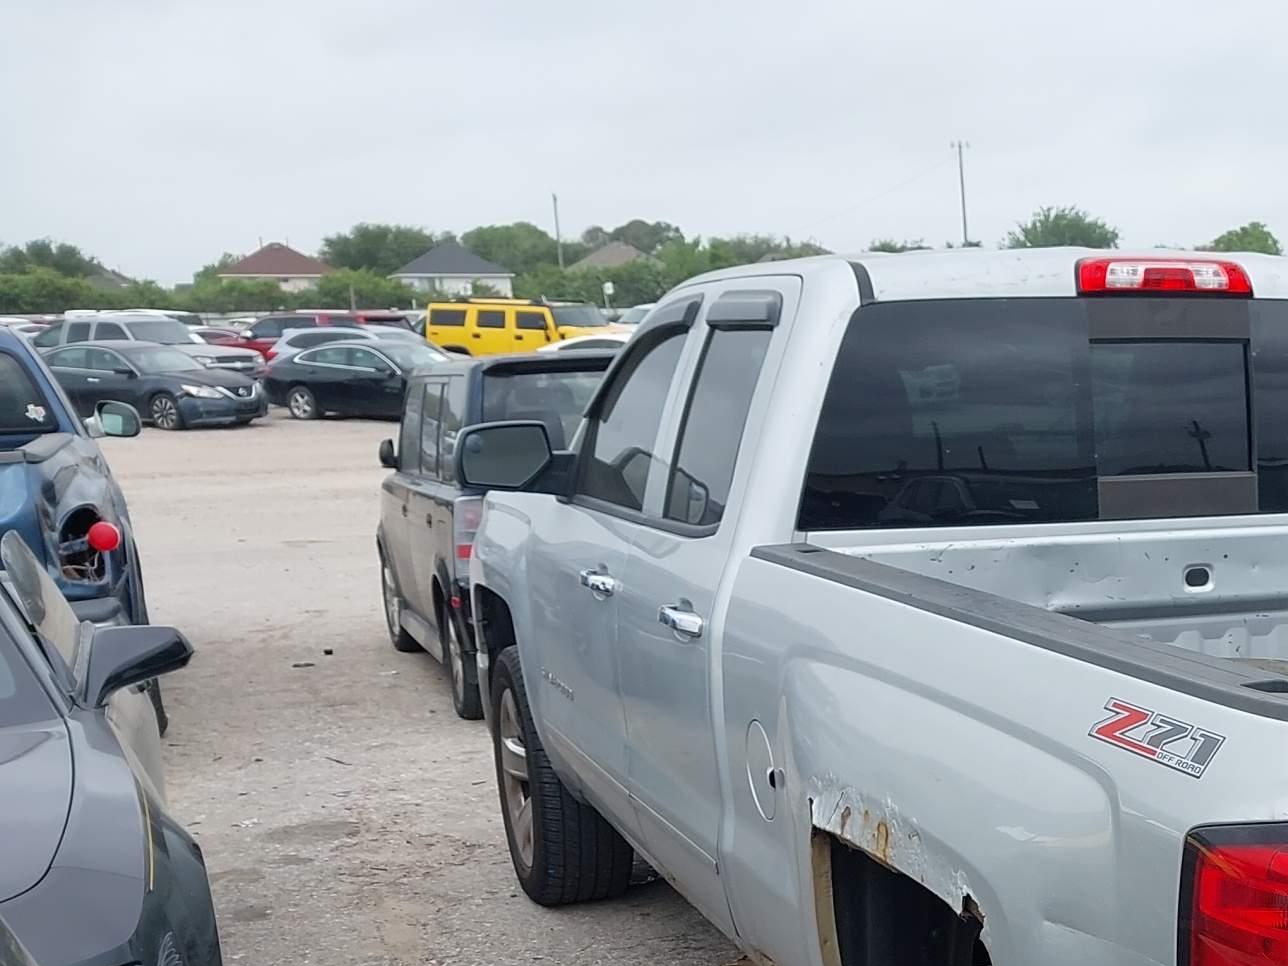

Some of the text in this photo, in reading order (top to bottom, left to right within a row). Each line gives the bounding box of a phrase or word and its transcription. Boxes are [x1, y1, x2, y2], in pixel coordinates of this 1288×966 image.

[1088, 697, 1226, 770] Z71
[1156, 751, 1202, 774] OFF ROAD
